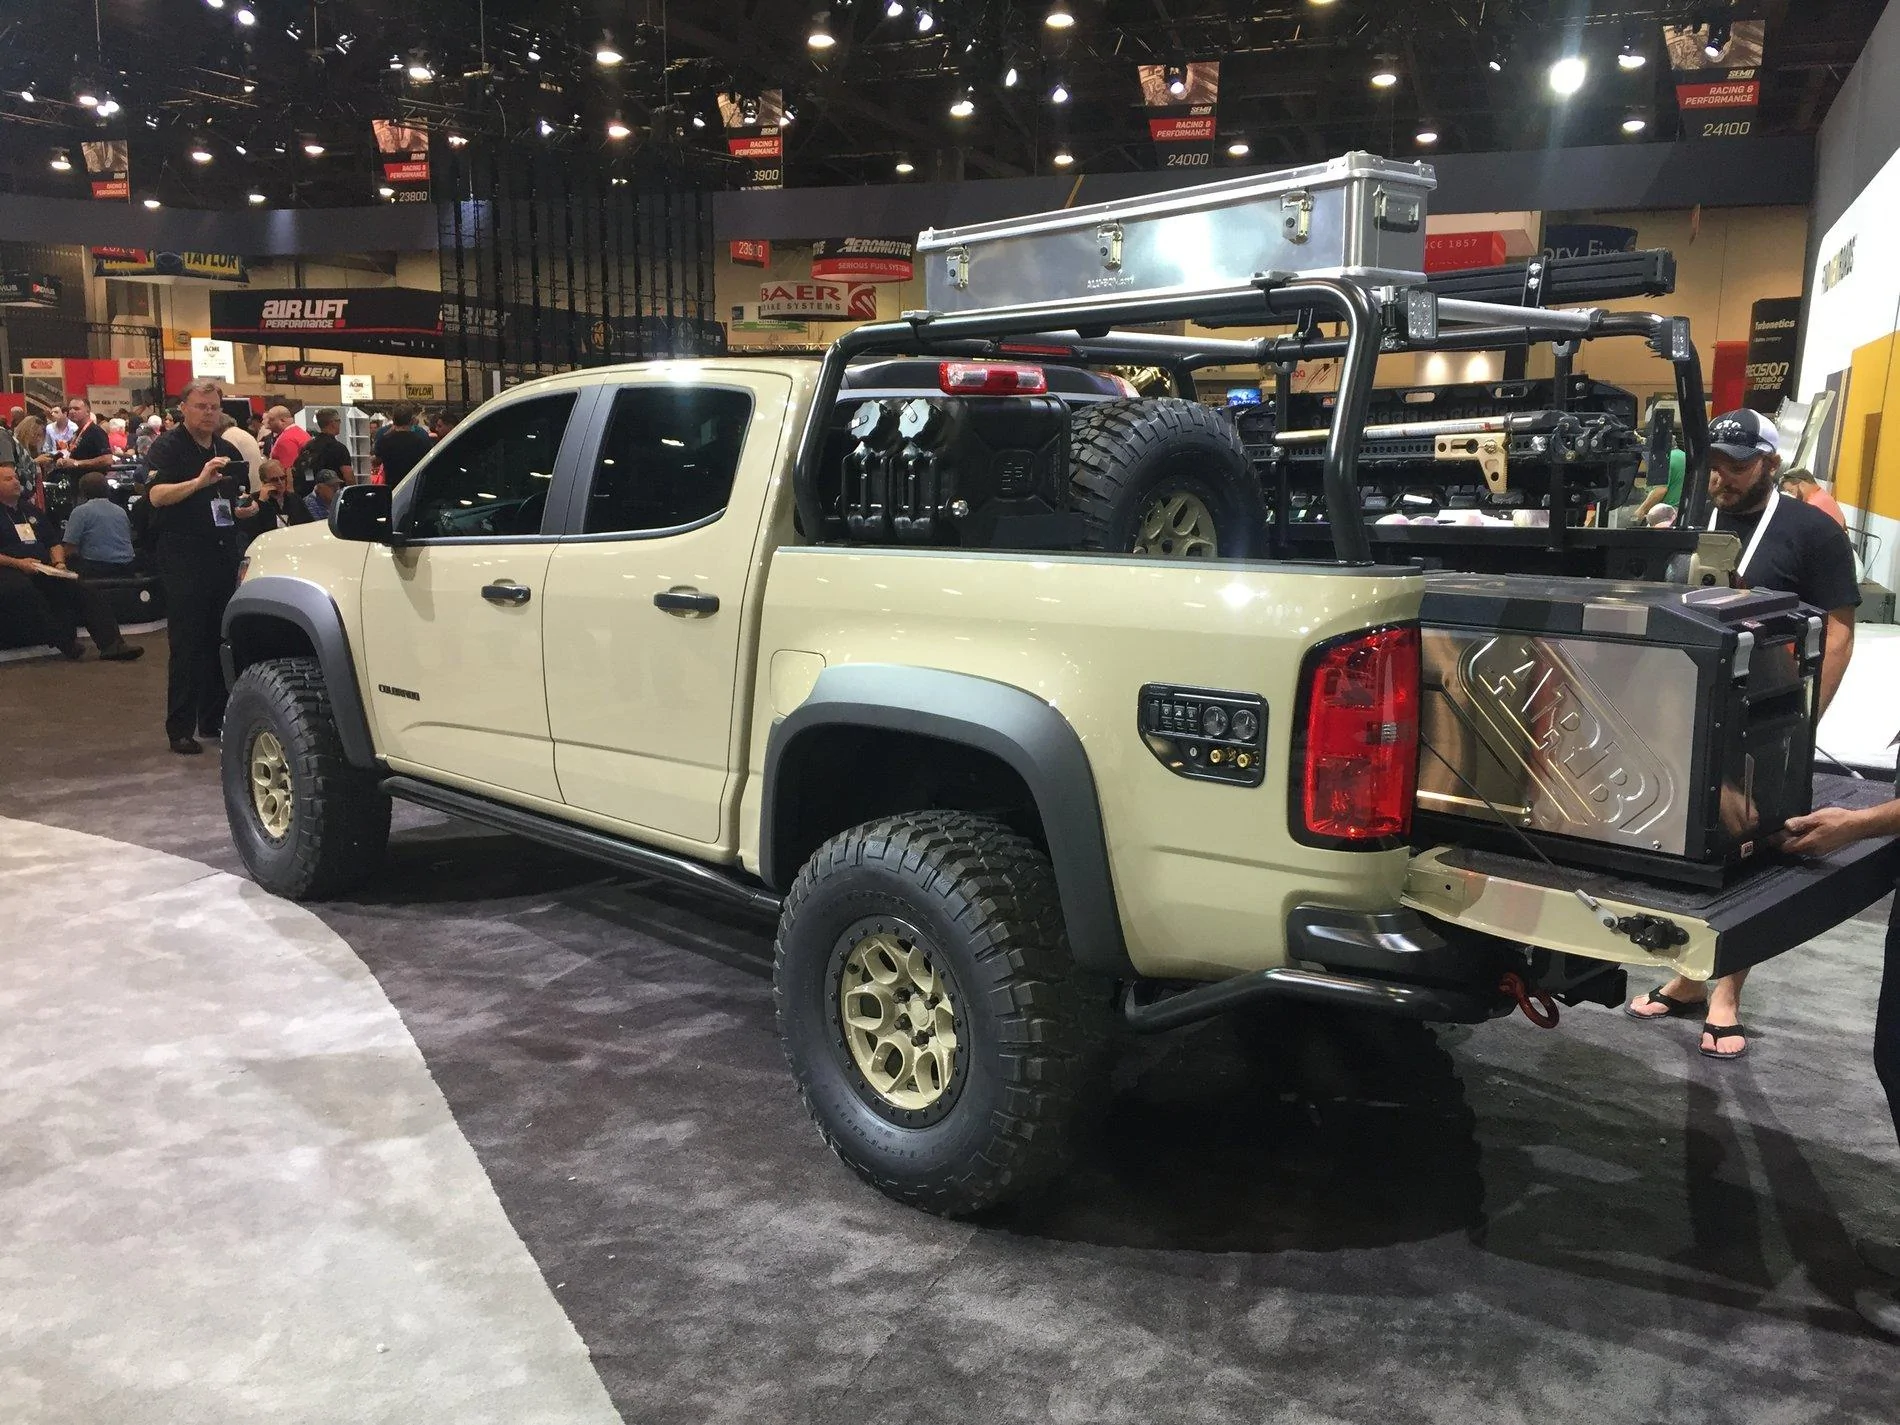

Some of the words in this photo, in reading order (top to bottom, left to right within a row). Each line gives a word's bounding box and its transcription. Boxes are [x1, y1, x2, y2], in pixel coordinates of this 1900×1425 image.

[1709, 86, 1745, 95] RACING
[1685, 94, 1753, 105] PERFORMANCE
[1157, 129, 1211, 137] PERFORMANCE
[1703, 122, 1750, 136] 24100
[735, 147, 779, 155] PERFORMANCE
[1167, 153, 1209, 166] 24000
[747, 169, 779, 181] 3900
[399, 191, 428, 202] 23800
[836, 238, 912, 257] AEROMOTIVE
[1449, 239, 1478, 248] 1857
[738, 241, 763, 258] 2390
[838, 262, 868, 270] SERIOUS
[870, 262, 888, 270] FUEL
[304, 299, 348, 319] LIFT
[786, 302, 841, 311] SYSTEMS
[265, 319, 334, 329] PERFORMANCE
[407, 386, 433, 398] TAYLOR
[1478, 640, 1647, 825] ARB
